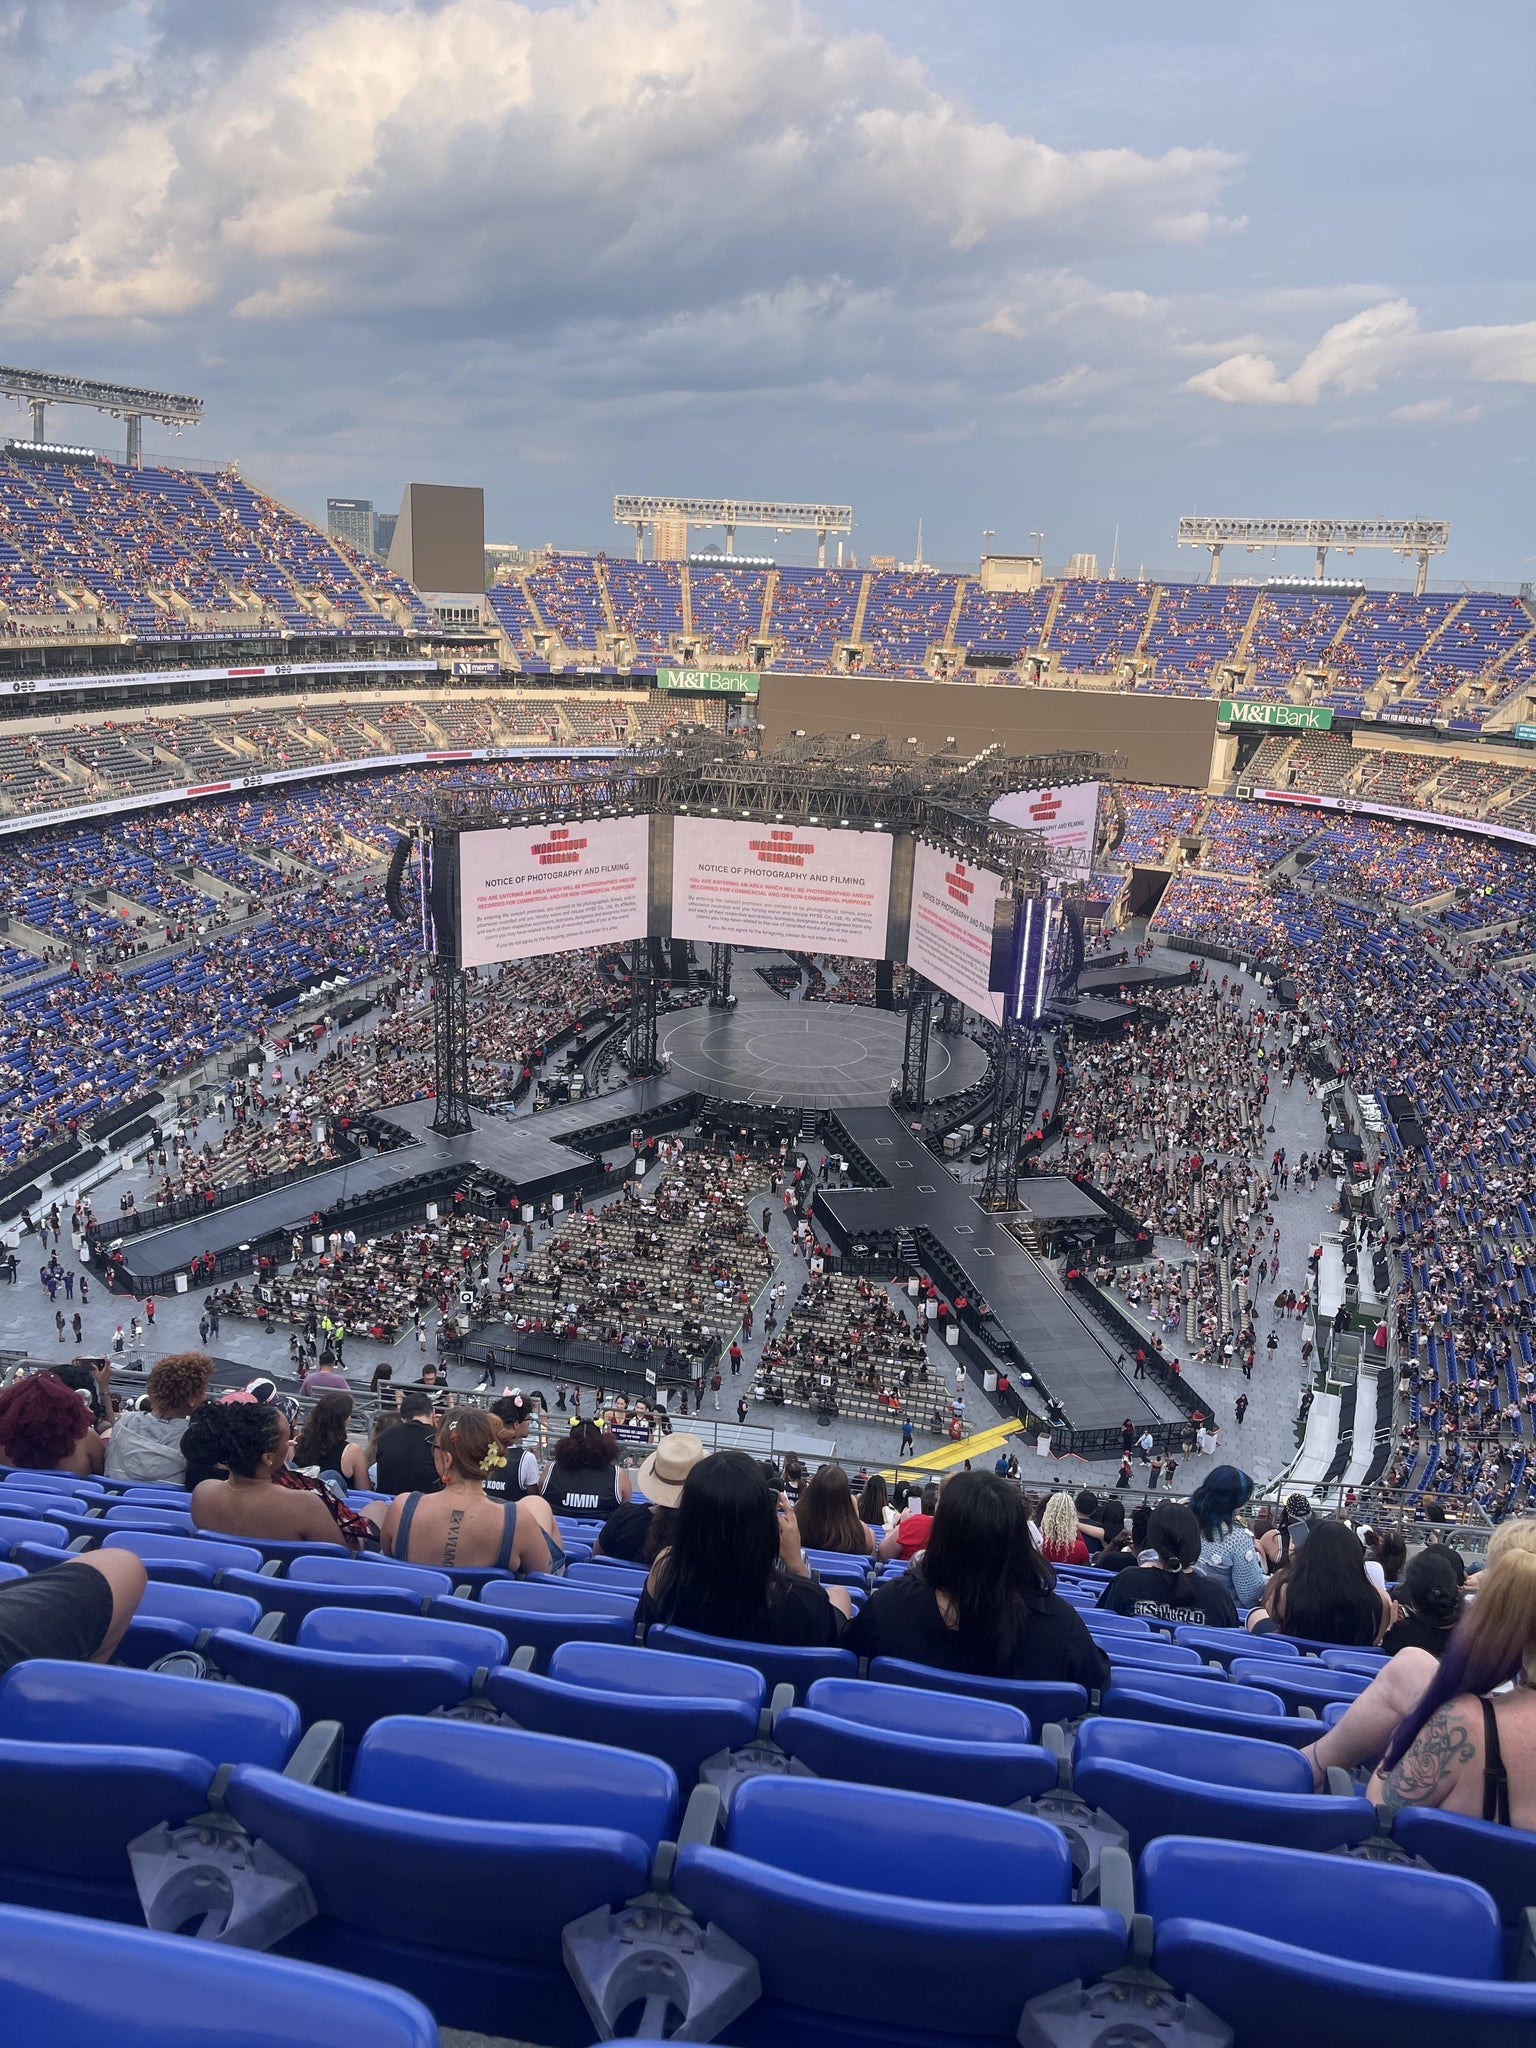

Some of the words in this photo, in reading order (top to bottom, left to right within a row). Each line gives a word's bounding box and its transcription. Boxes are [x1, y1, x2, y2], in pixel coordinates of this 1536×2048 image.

[668, 671, 709, 688] M&T
[710, 673, 748, 690] Bank
[1229, 702, 1276, 724] M&T
[1276, 706, 1319, 728] Bank
[533, 841, 561, 854] WORLD
[563, 838, 584, 851] TOUR
[751, 839, 786, 852] WORLD
[787, 842, 811, 855] TOUR
[485, 876, 513, 887] NOTICE
[515, 875, 525, 884] OF
[527, 868, 582, 882] PHOTOGRAPHY
[584, 866, 599, 875] AND
[601, 862, 629, 873] FILMING
[698, 863, 728, 873] NOTICE
[730, 866, 741, 874] OF
[744, 867, 807, 880] PHOTOGRAPHY
[809, 873, 828, 882] AND
[830, 875, 865, 886] FILMING
[923, 890, 935, 903] NOTICE
[462, 1293, 471, 1302] Q
[487, 1480, 505, 1490] KOOK
[562, 1493, 599, 1508] JIMIN
